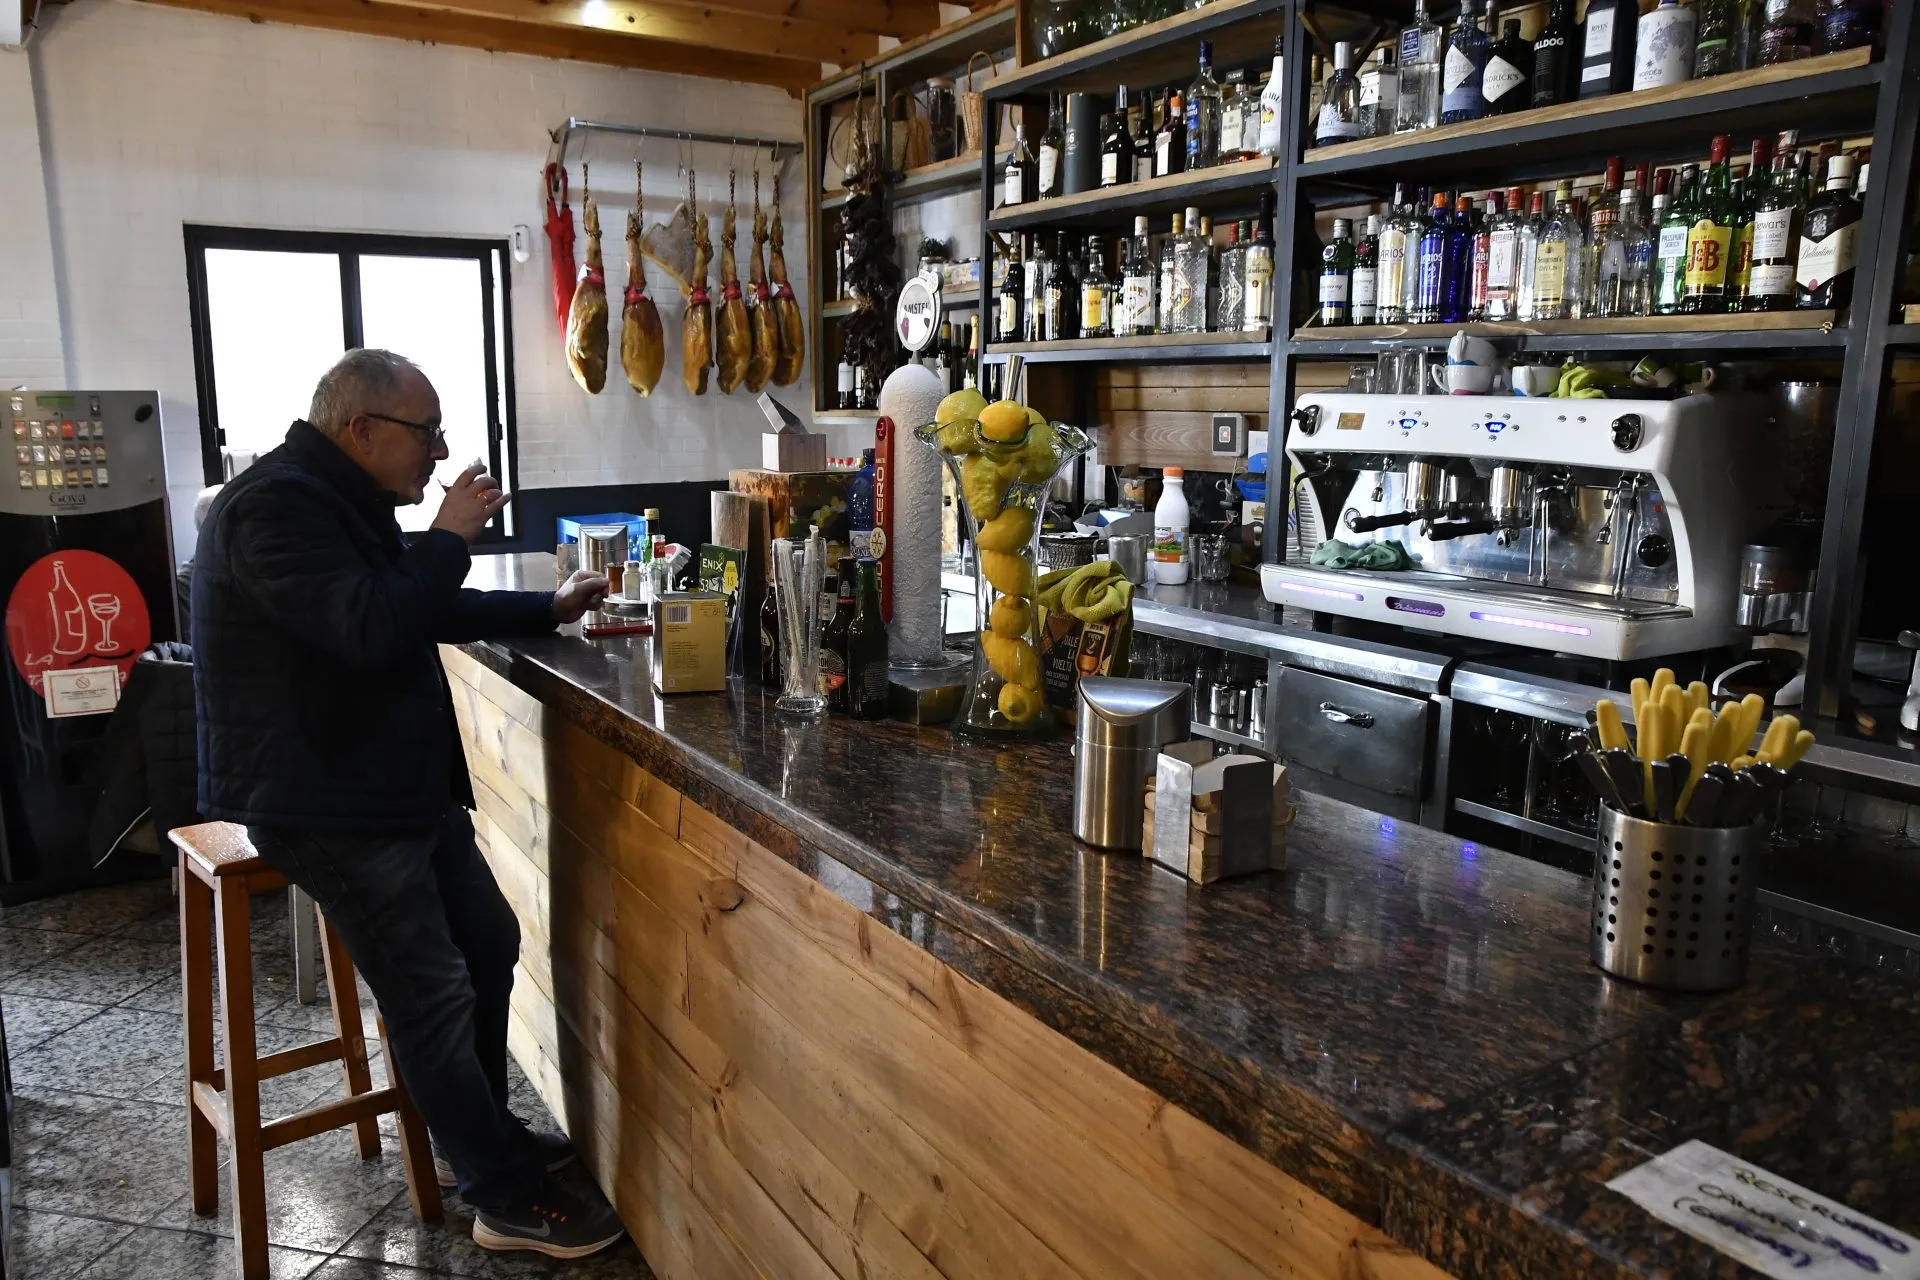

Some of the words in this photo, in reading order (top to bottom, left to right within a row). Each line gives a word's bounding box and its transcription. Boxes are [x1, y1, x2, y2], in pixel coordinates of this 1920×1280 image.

[1533, 37, 1564, 51] LLDOG
[1380, 248, 1404, 258] ARIOS
[1687, 239, 1720, 272] J&B
[876, 466, 885, 526] CERO
[702, 557, 724, 572] ENIX
